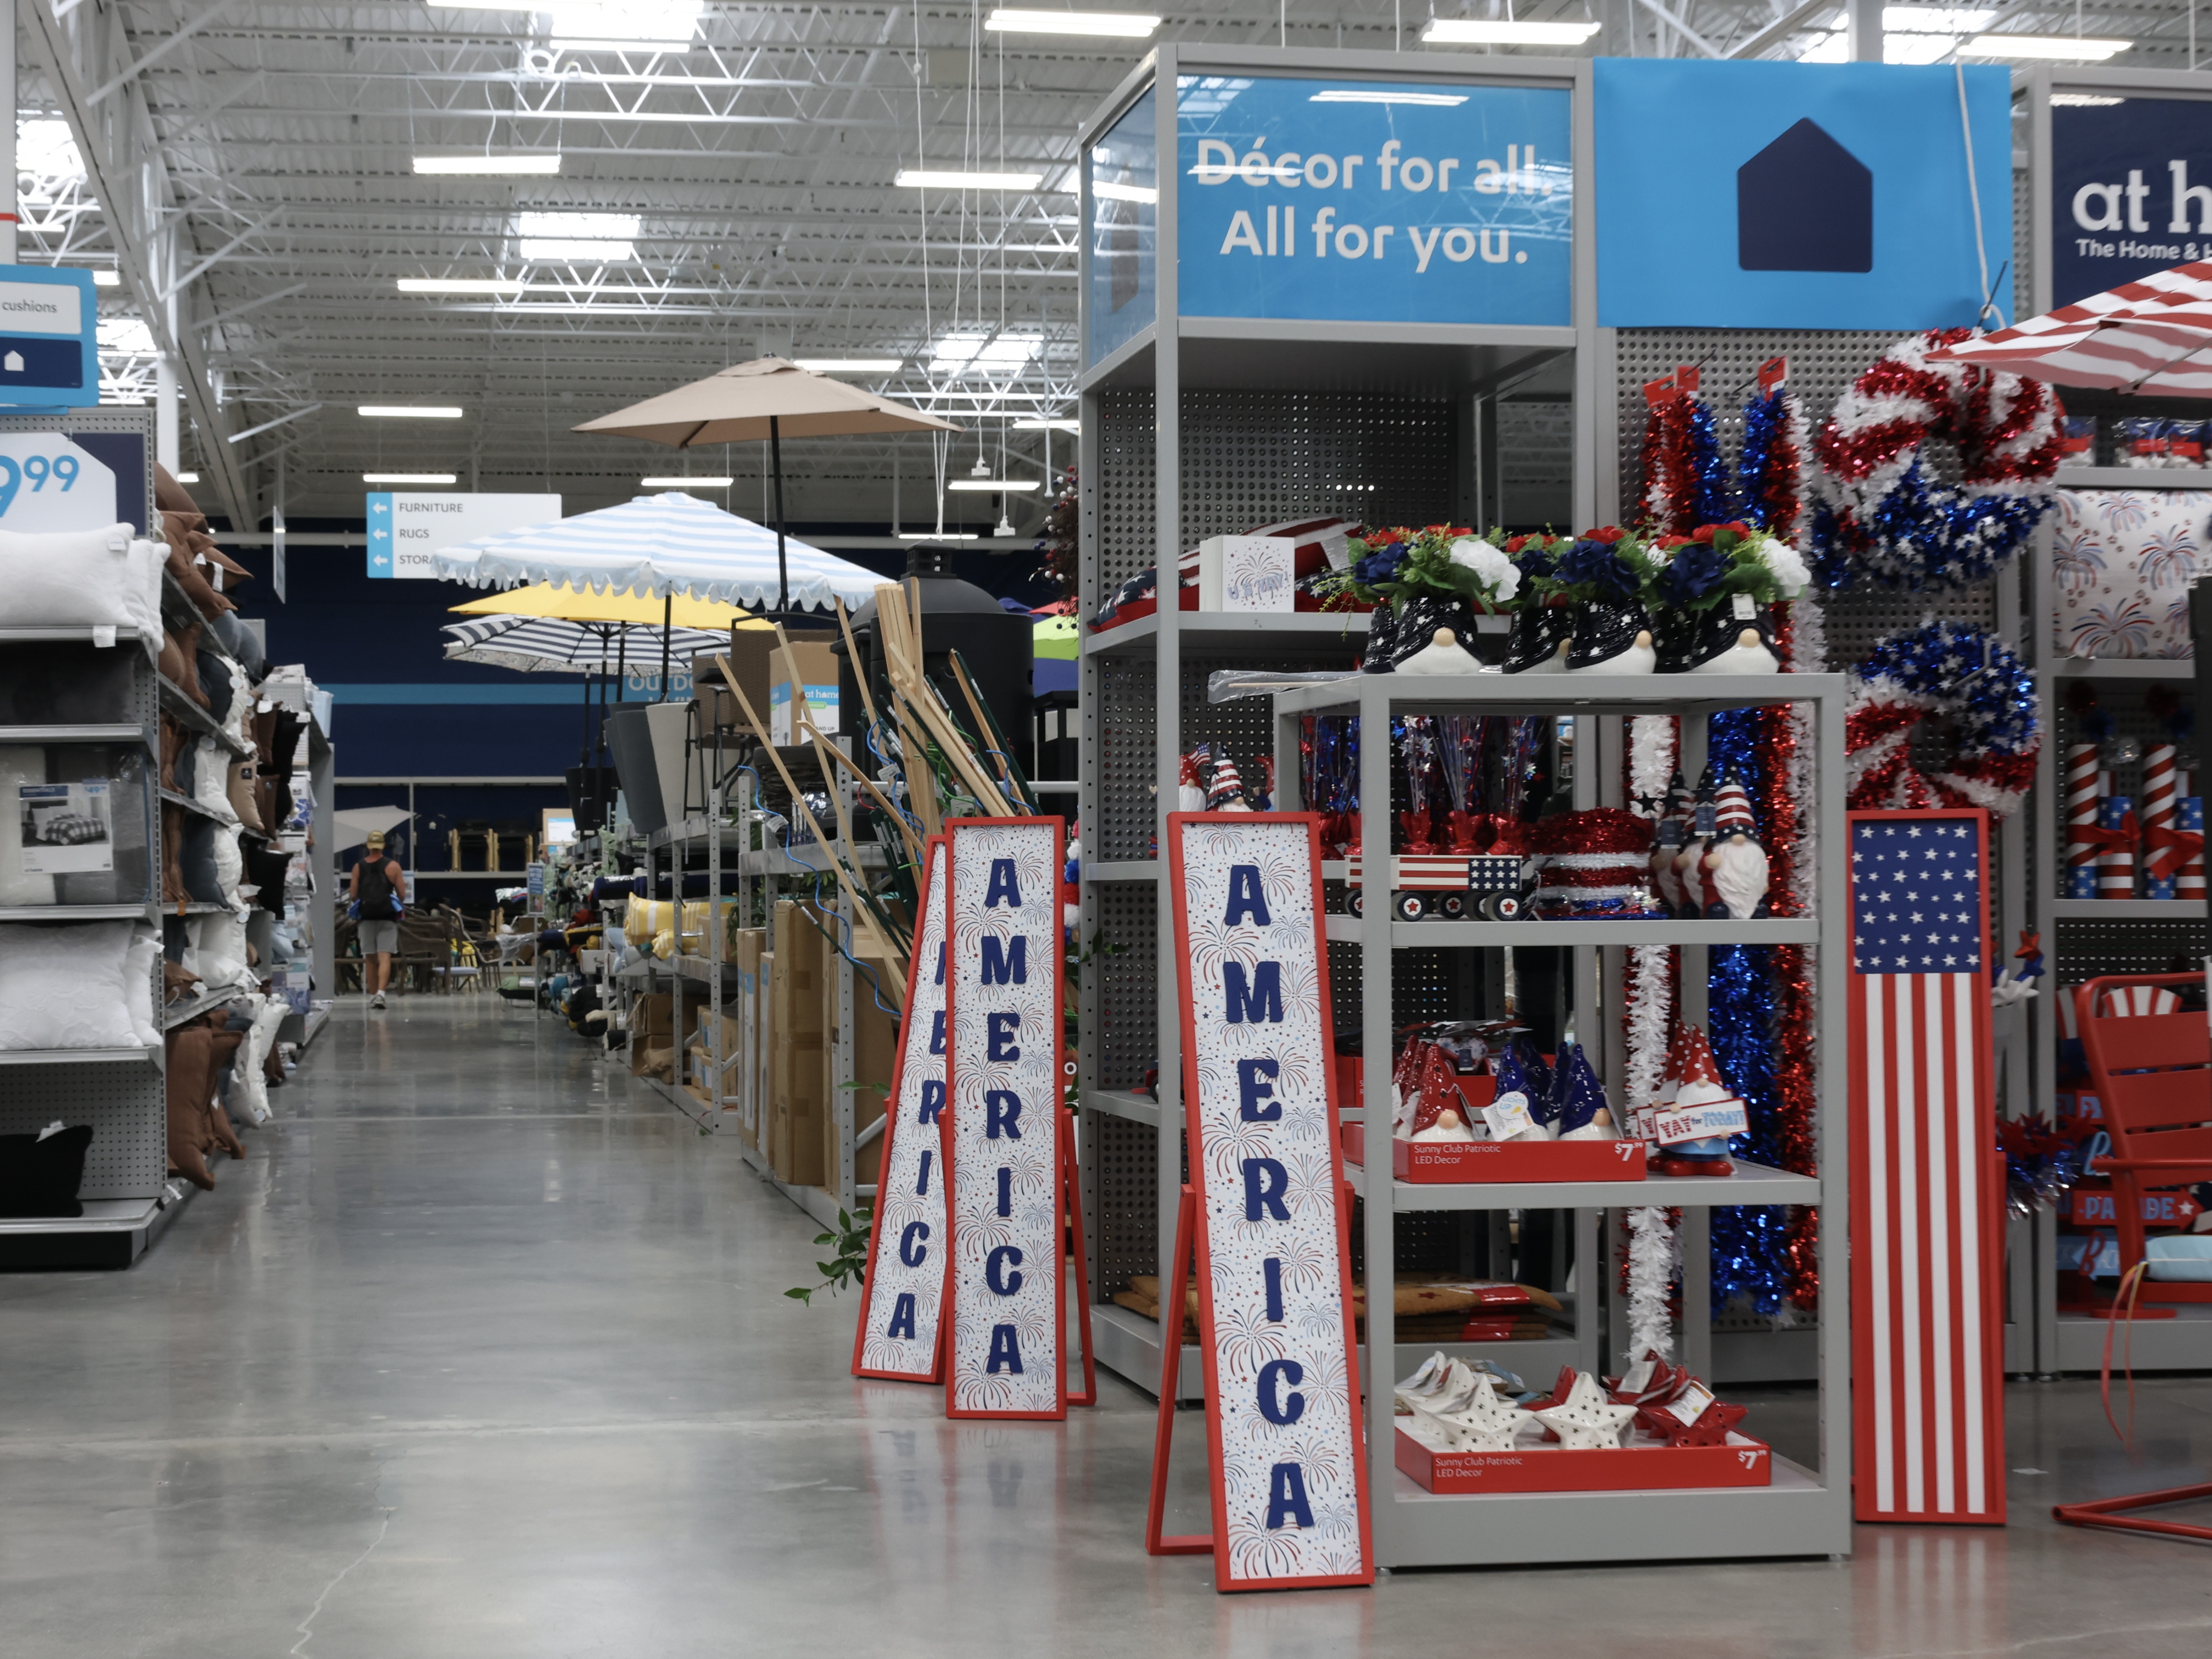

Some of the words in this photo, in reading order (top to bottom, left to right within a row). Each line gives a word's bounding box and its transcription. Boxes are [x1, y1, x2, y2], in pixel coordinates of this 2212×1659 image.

[1198, 136, 1363, 189] Décor
[1377, 139, 1459, 193] for
[1474, 144, 1553, 196] all.
[2072, 169, 2151, 233] at
[1219, 205, 1295, 257] All
[1311, 206, 1394, 260] for
[1407, 226, 1528, 274] you.
[2075, 238, 2115, 257] The
[2119, 240, 2181, 260] Home
[2183, 242, 2200, 260] &
[2, 299, 58, 313] cushions
[399, 503, 464, 513] FURNITURE
[399, 529, 430, 539] RUGS
[399, 555, 432, 565] STOR
[981, 858, 1026, 1374] AMERICA
[1659, 1115, 1692, 1138] YAY
[1414, 1145, 1442, 1155] Sunny
[1443, 1144, 1463, 1153] Club
[1465, 1144, 1501, 1152] Patriotic
[1415, 1156, 1433, 1164] LED
[1434, 1155, 1462, 1164] Decor
[1223, 864, 1314, 1529] AMERICA
[1435, 1457, 1463, 1468] Sunny
[1464, 1457, 1485, 1466] Club
[1486, 1456, 1523, 1466] Patriotic
[1436, 1468, 1454, 1478] LED
[1455, 1468, 1483, 1477] Decor
